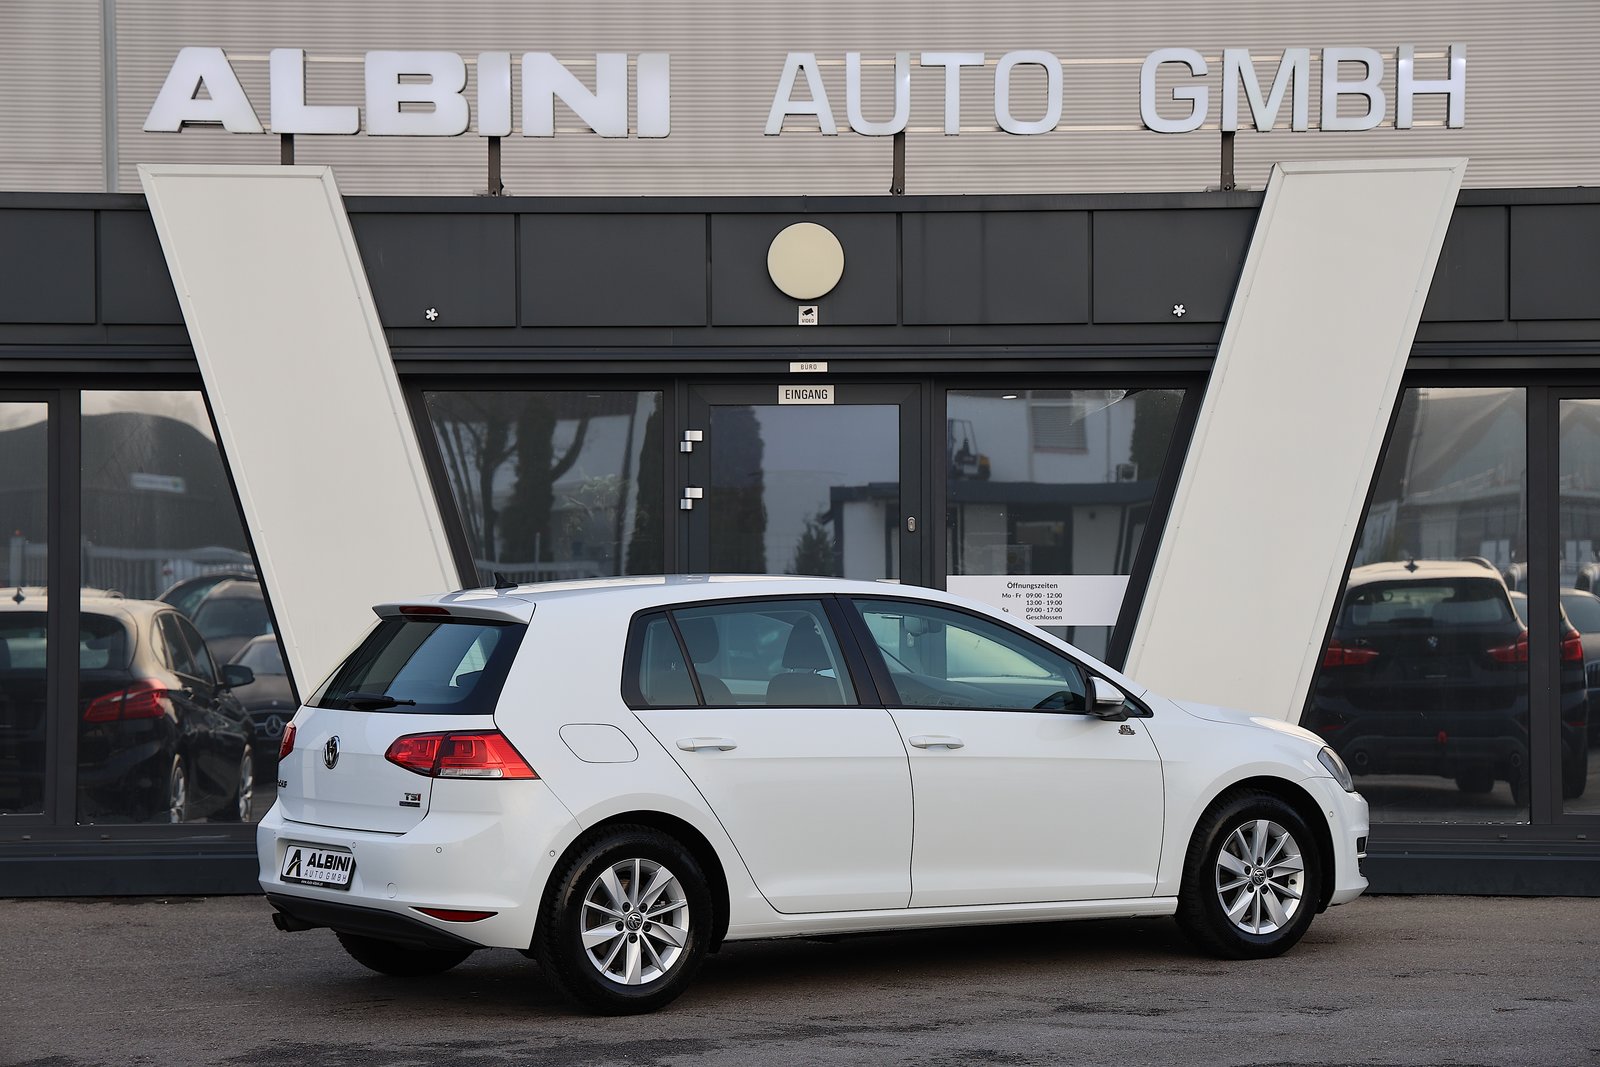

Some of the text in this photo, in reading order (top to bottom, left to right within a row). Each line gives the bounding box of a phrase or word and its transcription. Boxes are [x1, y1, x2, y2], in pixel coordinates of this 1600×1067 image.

[143, 44, 1468, 138] ALBINI AUTO GMBH
[785, 389, 828, 400] EINGANG
[1007, 582, 1058, 590] Öffnungszeiten
[404, 792, 421, 801] TSI
[307, 852, 351, 872] ALBINI
[304, 869, 324, 880] AUTO
[325, 871, 347, 883] GMBH
